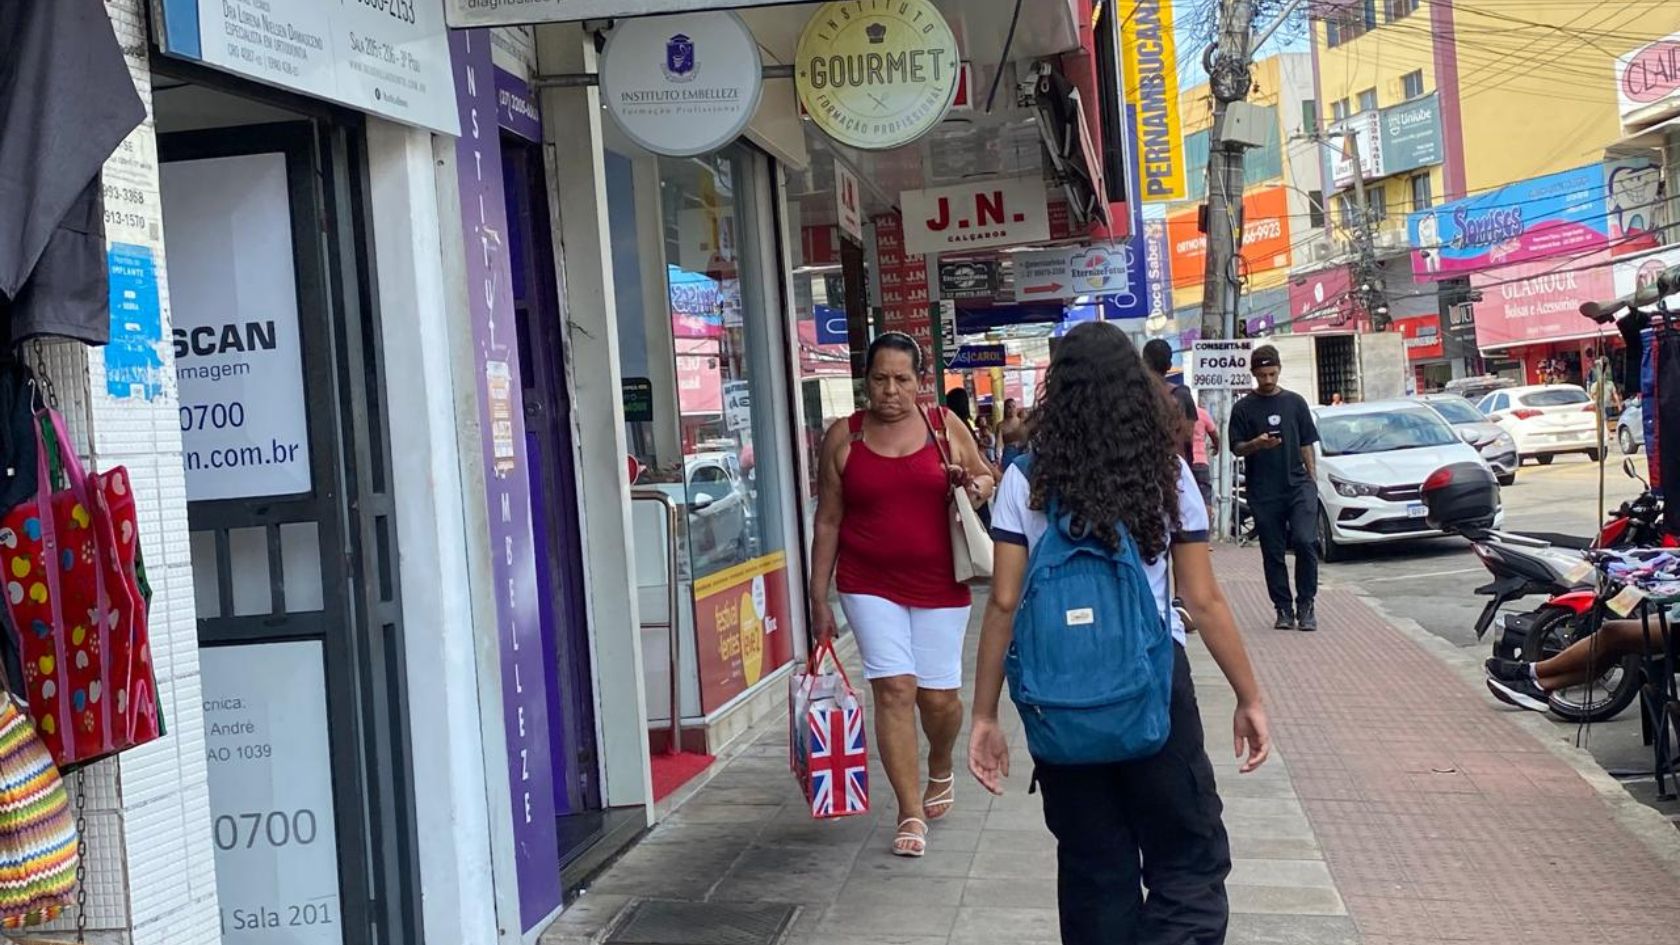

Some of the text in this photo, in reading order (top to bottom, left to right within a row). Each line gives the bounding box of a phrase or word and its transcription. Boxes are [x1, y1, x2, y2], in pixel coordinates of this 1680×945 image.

[818, 0, 935, 41] INSTITUTO
[810, 49, 944, 89] GOURMET
[621, 87, 739, 101] INSTITUTO EMBELLEZE
[1134, 0, 1174, 196] PERNAMBUCAN
[622, 105, 740, 116] Formação Profissional
[816, 86, 943, 136] FORMAÇÃO PROFISSIONAL
[926, 190, 1025, 232] J.N.
[947, 230, 1007, 243] CALÇADOS
[1147, 236, 1160, 280] Saber
[1501, 271, 1578, 300] GLAMOUR
[1195, 342, 1252, 350] CONSERTA-SE
[1200, 355, 1246, 368] FOGÃO
[1194, 374, 1223, 386] 99660
[183, 438, 300, 471] n.com.br
[237, 744, 273, 759] 1039
[213, 808, 317, 851] 0700
[233, 903, 333, 931] Sala 201
